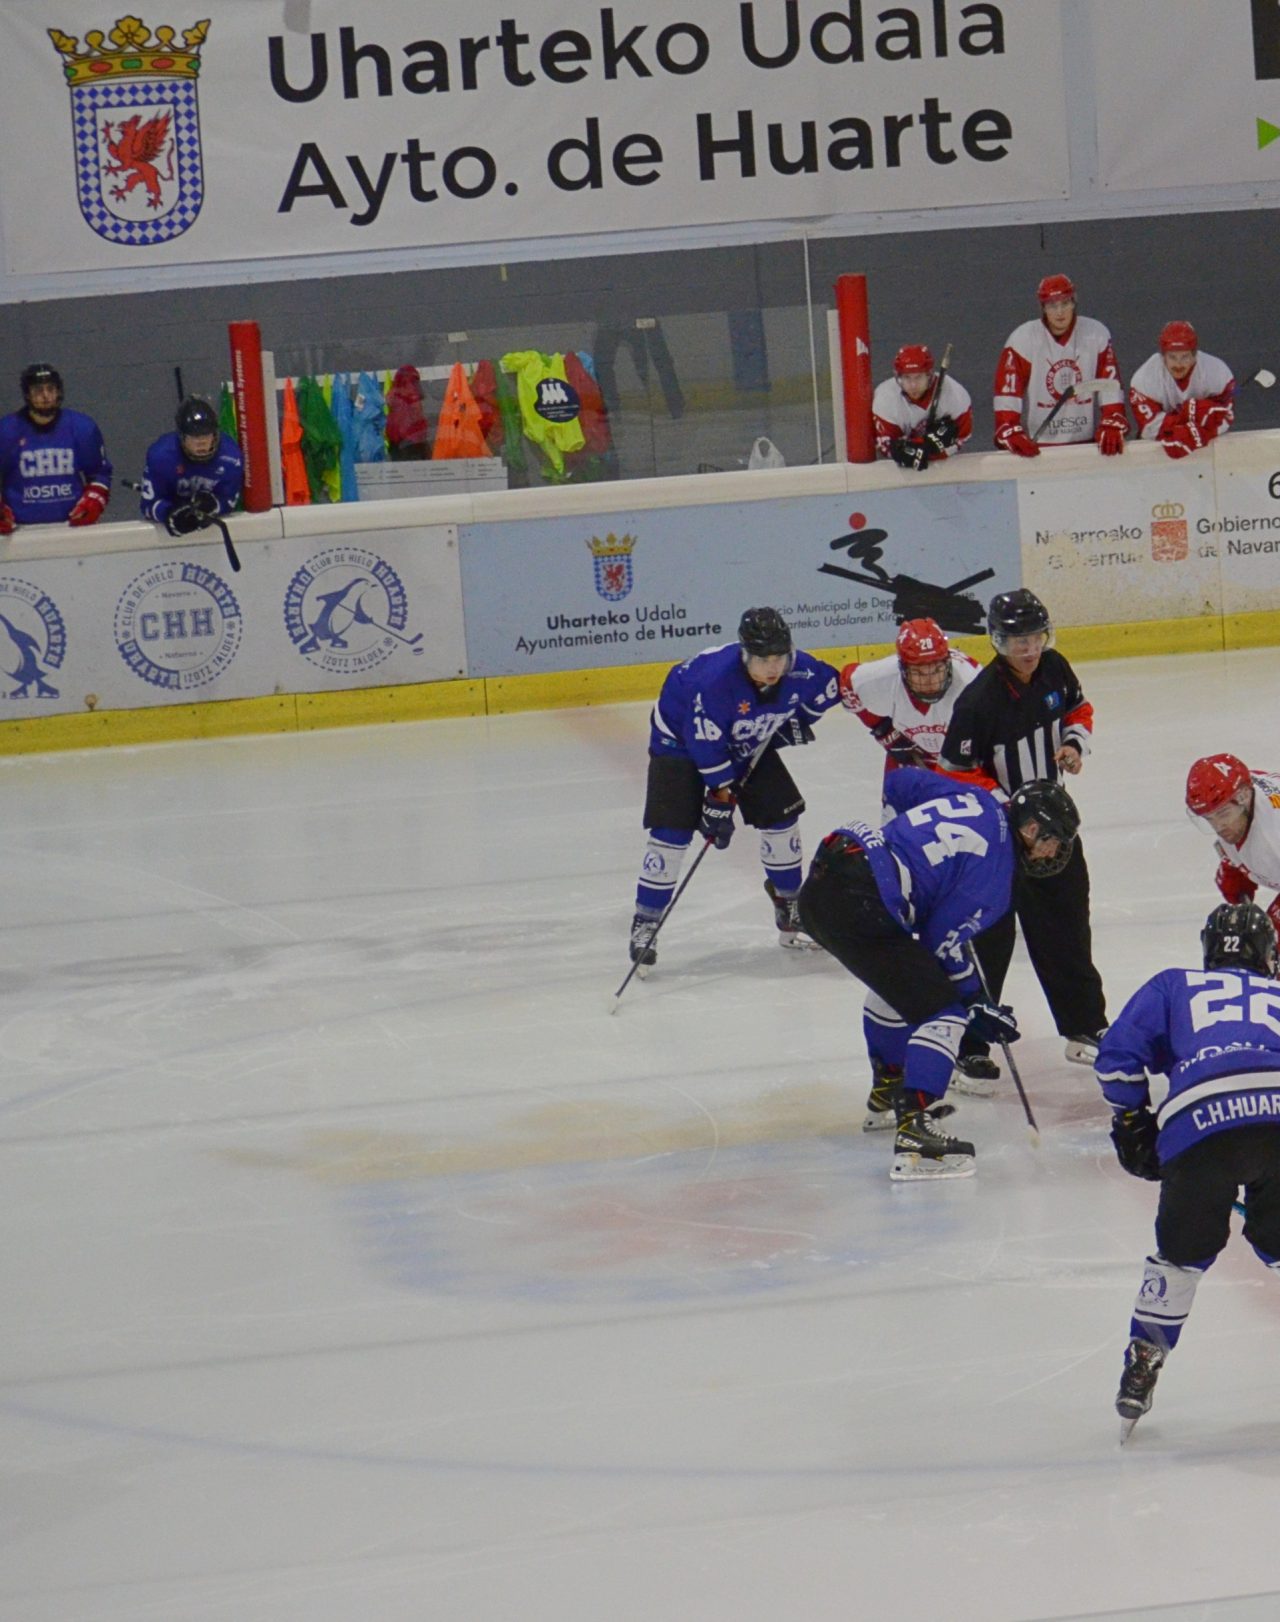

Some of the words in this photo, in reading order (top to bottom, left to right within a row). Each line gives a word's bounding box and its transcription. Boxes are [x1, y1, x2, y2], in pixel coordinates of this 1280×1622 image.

[269, 8, 710, 103] Uharteko
[741, 0, 1006, 70] Udala
[278, 138, 518, 226] Ayto.
[547, 117, 663, 191] de
[697, 98, 1012, 181] Huarte
[20, 448, 75, 478] CHH
[546, 610, 630, 631] Uharteko
[635, 603, 687, 622] Udala
[797, 598, 851, 614] Municipal
[854, 597, 868, 610] de
[824, 613, 874, 628] Udalaren
[140, 607, 215, 641] CHH
[515, 629, 629, 655] Ayuntamiento
[635, 625, 656, 641] de
[660, 622, 722, 639] Huarte
[906, 792, 989, 867] 24
[1224, 936, 1240, 953] 22
